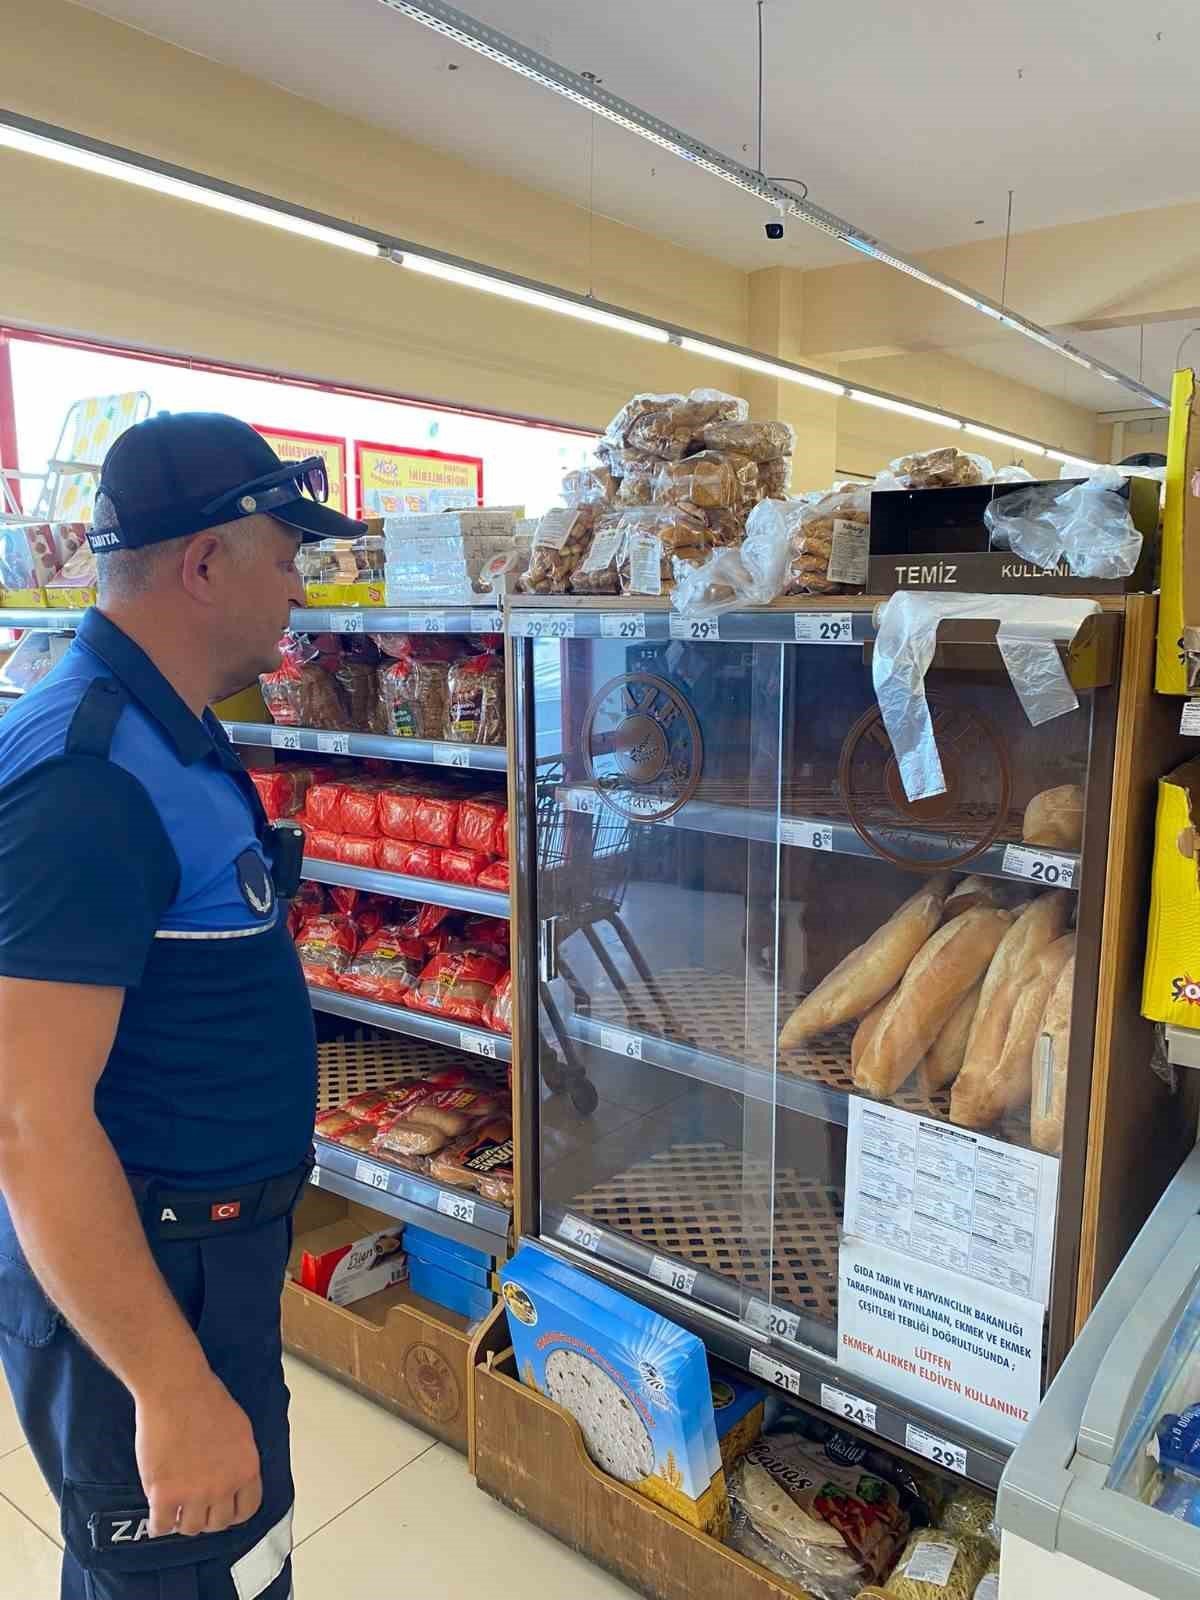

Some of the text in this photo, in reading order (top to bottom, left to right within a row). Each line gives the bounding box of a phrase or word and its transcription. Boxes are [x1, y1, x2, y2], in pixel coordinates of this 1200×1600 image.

[895, 561, 957, 584] TEMİZ
[160, 1207, 177, 1222] A
[853, 1263, 1024, 1337] GIDA TARIM VE HAYVANCILIK BAKANLIĞI
[846, 1276, 896, 1304] TARAFINDAN
[954, 1318, 985, 1340] EKMEK
[986, 1331, 998, 1345] VE
[1000, 1337, 1032, 1359] EKMEK
[914, 1345, 952, 1371] LÜTFEN
[842, 1333, 1030, 1422] EKMEK ALIRKEN ELDİVEN KULLANINIZ
[111, 1518, 150, 1542] ZA
